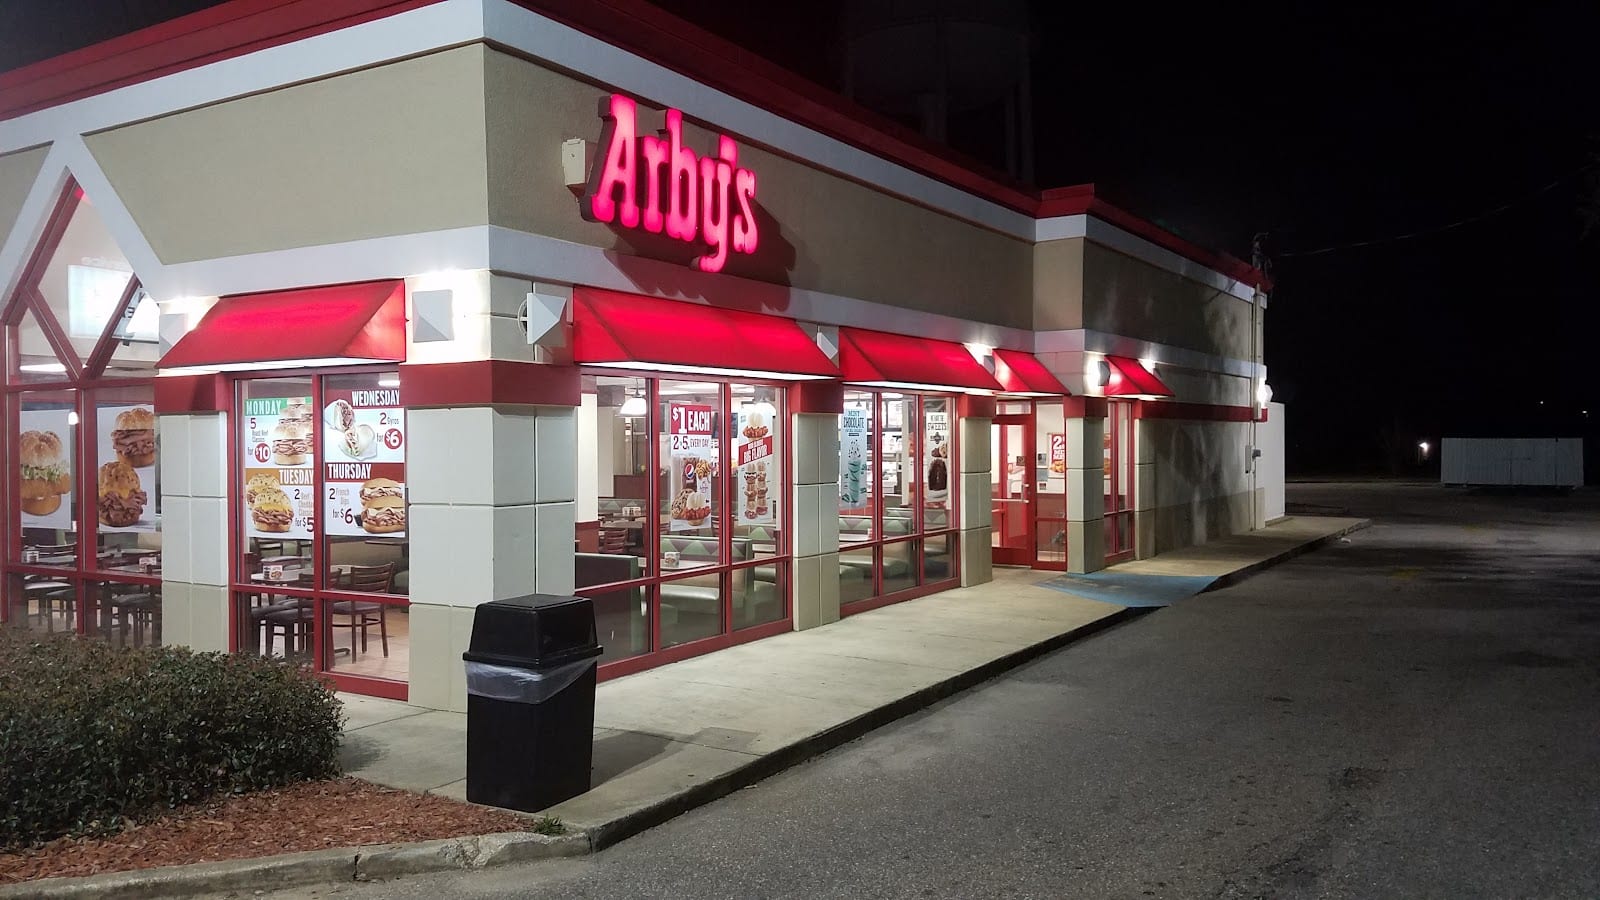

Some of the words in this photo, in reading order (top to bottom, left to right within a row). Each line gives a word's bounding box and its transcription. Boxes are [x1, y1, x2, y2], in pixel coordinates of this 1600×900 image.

[592, 94, 758, 273] Arby's
[351, 389, 400, 407] WEDNESDAY
[246, 399, 281, 416] MONDAY
[250, 417, 257, 430] 5
[379, 412, 387, 425] 2
[672, 407, 688, 434] $1
[687, 411, 710, 432] EACH
[843, 416, 865, 429] CHOCOLATE
[927, 422, 947, 431] SWEETS
[385, 430, 401, 448] $6
[690, 438, 701, 448] EVERY
[255, 446, 270, 460] $10
[279, 469, 314, 485] TUESDAY
[328, 463, 372, 480] THURSDAY
[294, 488, 301, 500] 2
[328, 488, 336, 500] 2
[302, 516, 314, 533] $5
[340, 508, 354, 525] $6
